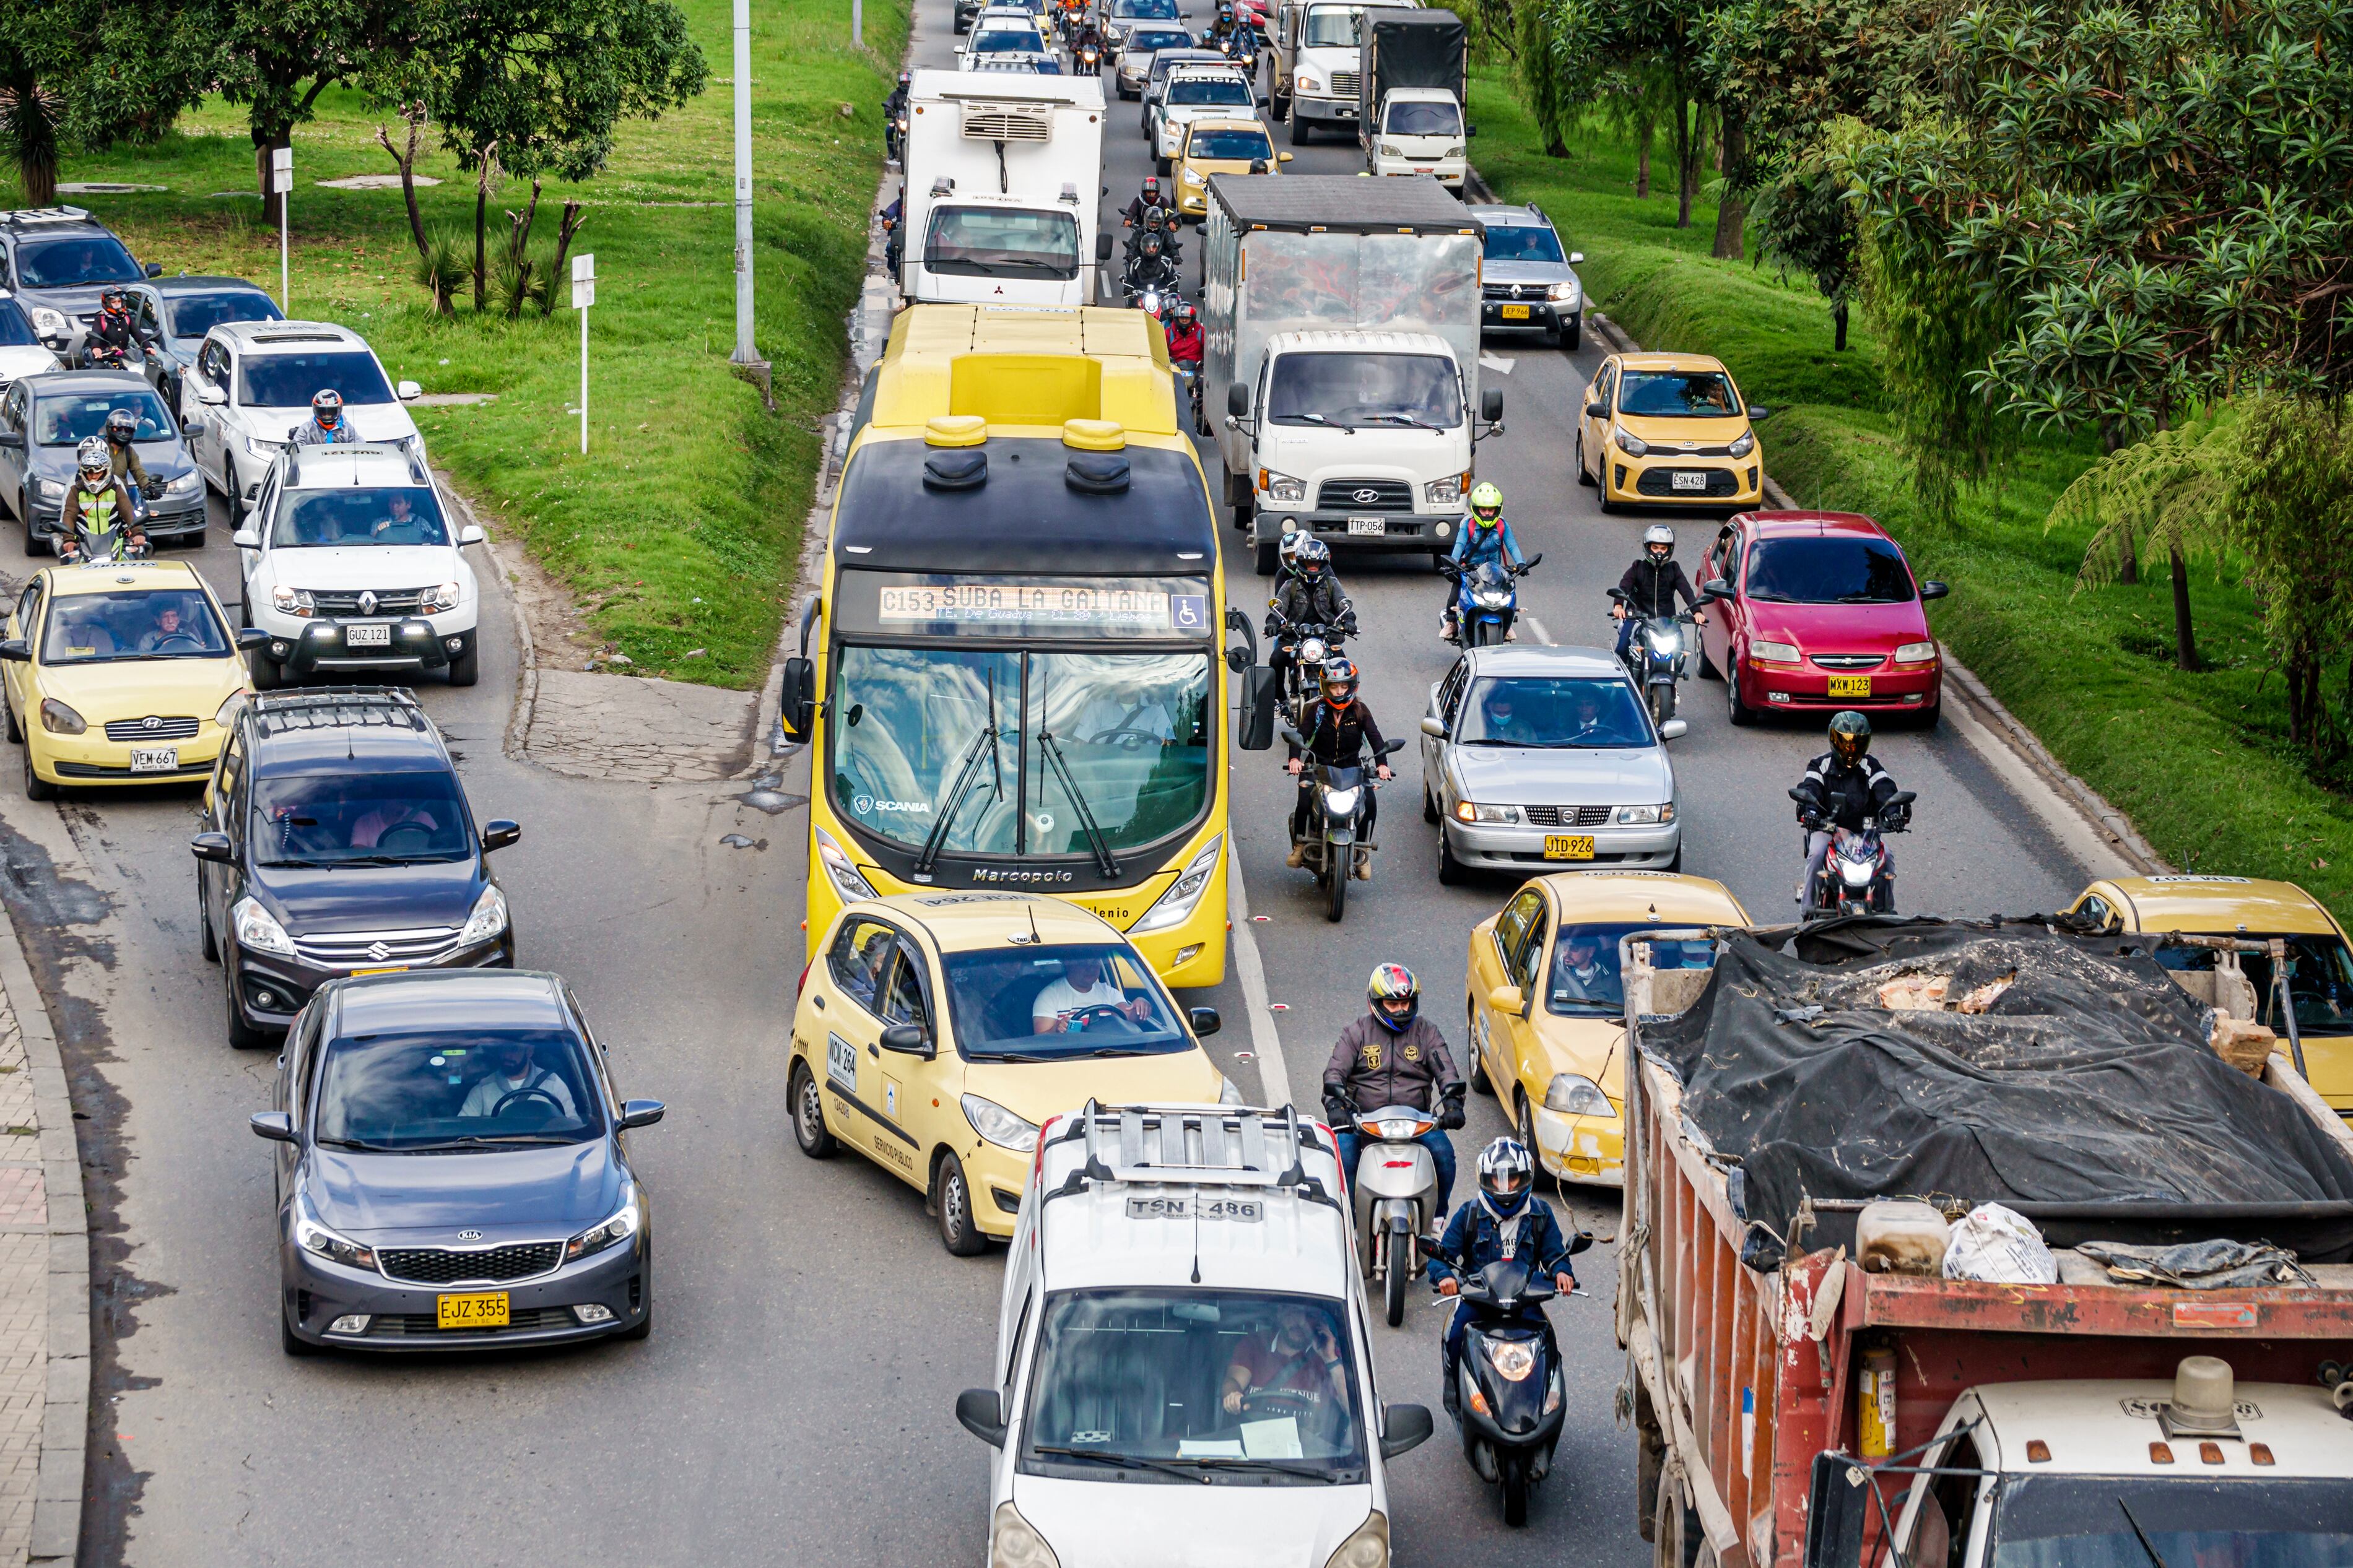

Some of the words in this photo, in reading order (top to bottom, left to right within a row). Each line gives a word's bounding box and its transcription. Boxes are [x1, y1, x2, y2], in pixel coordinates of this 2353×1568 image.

[1516, 307, 1528, 315] 966
[1674, 475, 1689, 485] ESN
[1690, 475, 1705, 485] 428
[883, 591, 934, 612] C153
[943, 587, 1002, 608] SUBA
[1019, 587, 1045, 609] LA
[1061, 588, 1163, 611] GAITANA
[349, 630, 367, 640] GUZ
[371, 629, 388, 639] 121
[1830, 678, 1848, 691] MXW
[1851, 678, 1869, 691] 123
[875, 800, 929, 813] SCANIA
[972, 868, 1072, 884] Marcopolo
[874, 1135, 894, 1159] SERVICIO
[1132, 1199, 1185, 1213] TSN
[1209, 1202, 1255, 1216] 486
[441, 1301, 471, 1319] EJZ
[476, 1299, 506, 1317] 355
